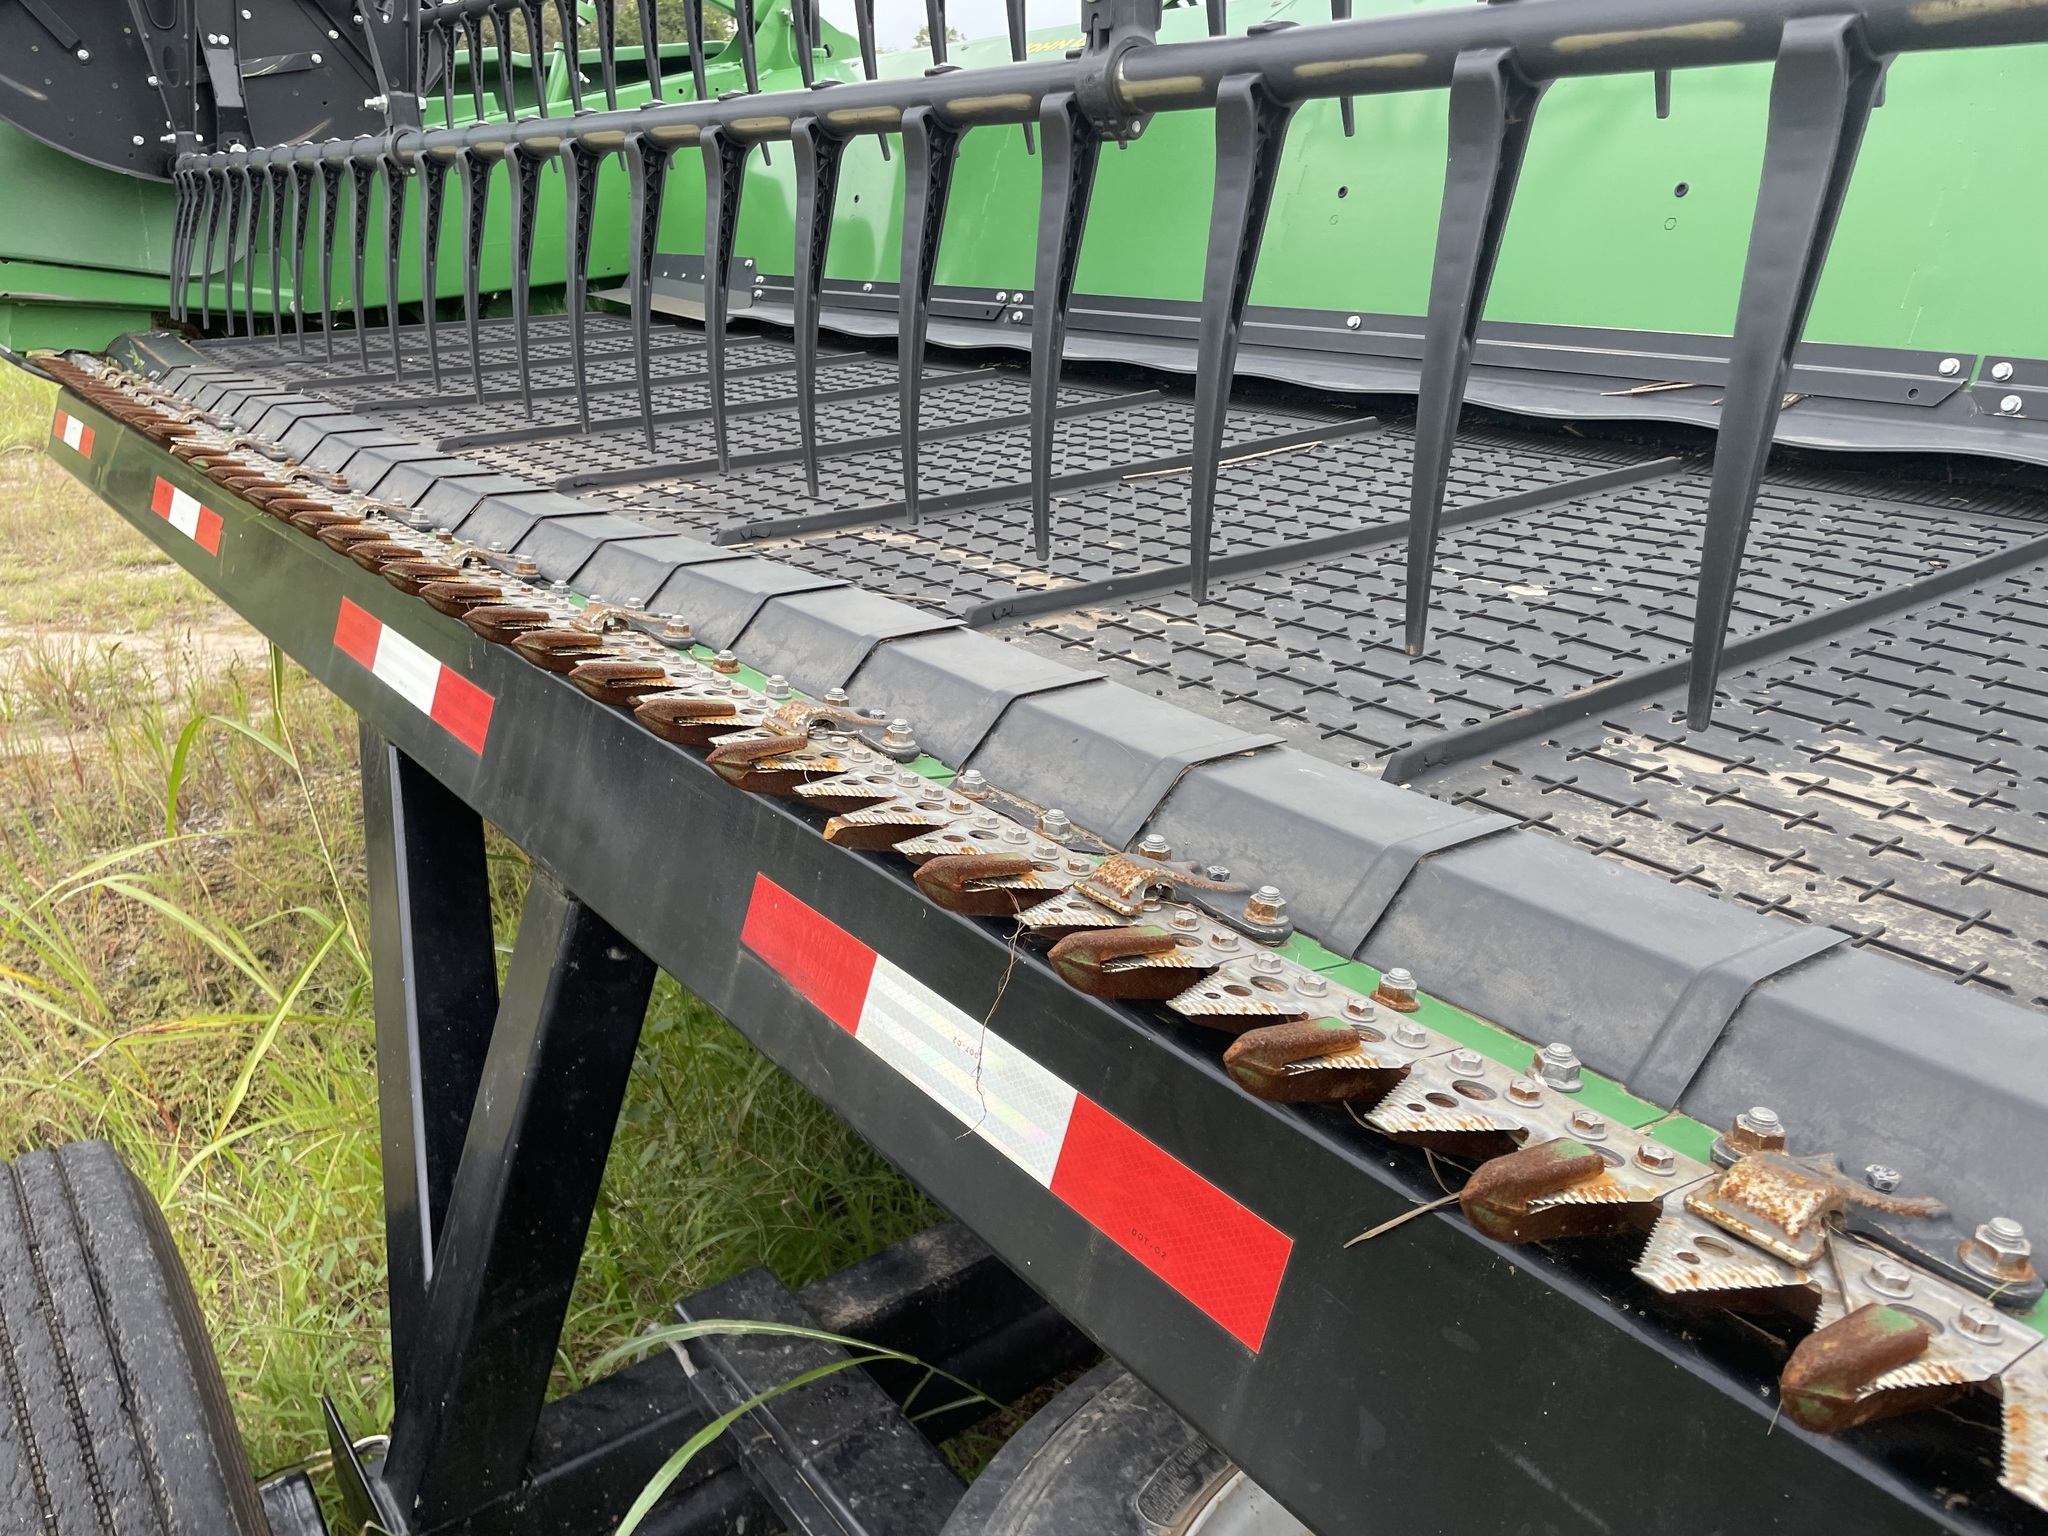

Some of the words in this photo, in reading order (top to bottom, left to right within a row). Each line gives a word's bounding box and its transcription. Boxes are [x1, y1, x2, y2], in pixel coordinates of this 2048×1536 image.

[1009, 39, 1074, 55] OHN
[952, 1036, 979, 1060] DOT-C2
[1131, 1227, 1167, 1260] DOT-C2
